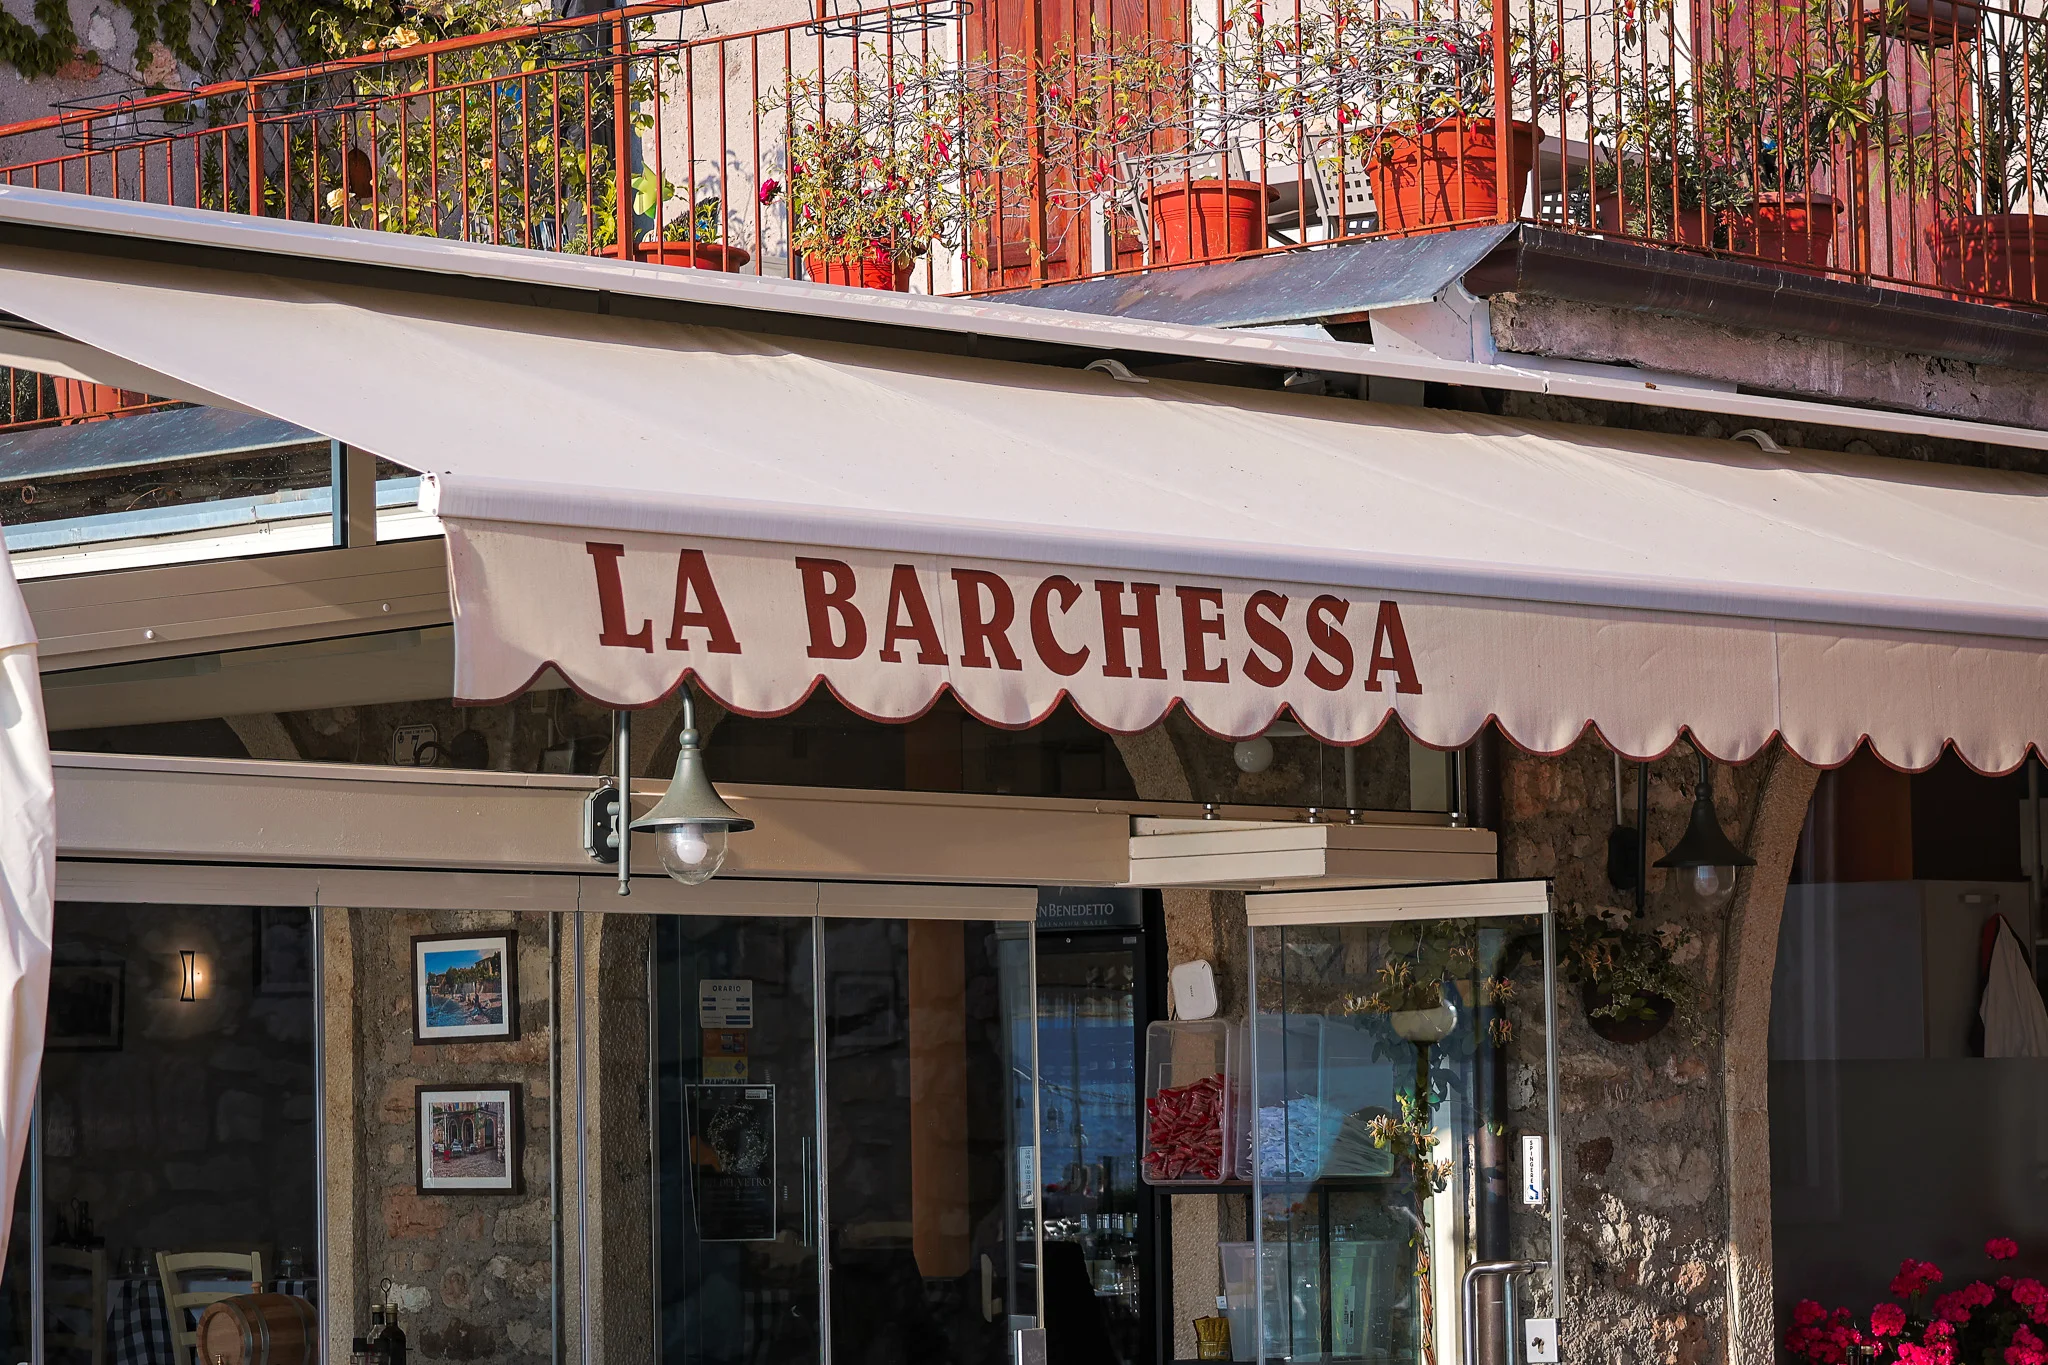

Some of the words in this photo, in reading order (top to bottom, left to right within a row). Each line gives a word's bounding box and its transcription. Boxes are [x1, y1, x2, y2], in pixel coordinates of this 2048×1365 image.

[586, 541, 742, 655] LA
[795, 556, 1423, 695] BARCHESSA
[1049, 903, 1114, 917] BENEDETTO
[738, 1176, 772, 1187] VETRO
